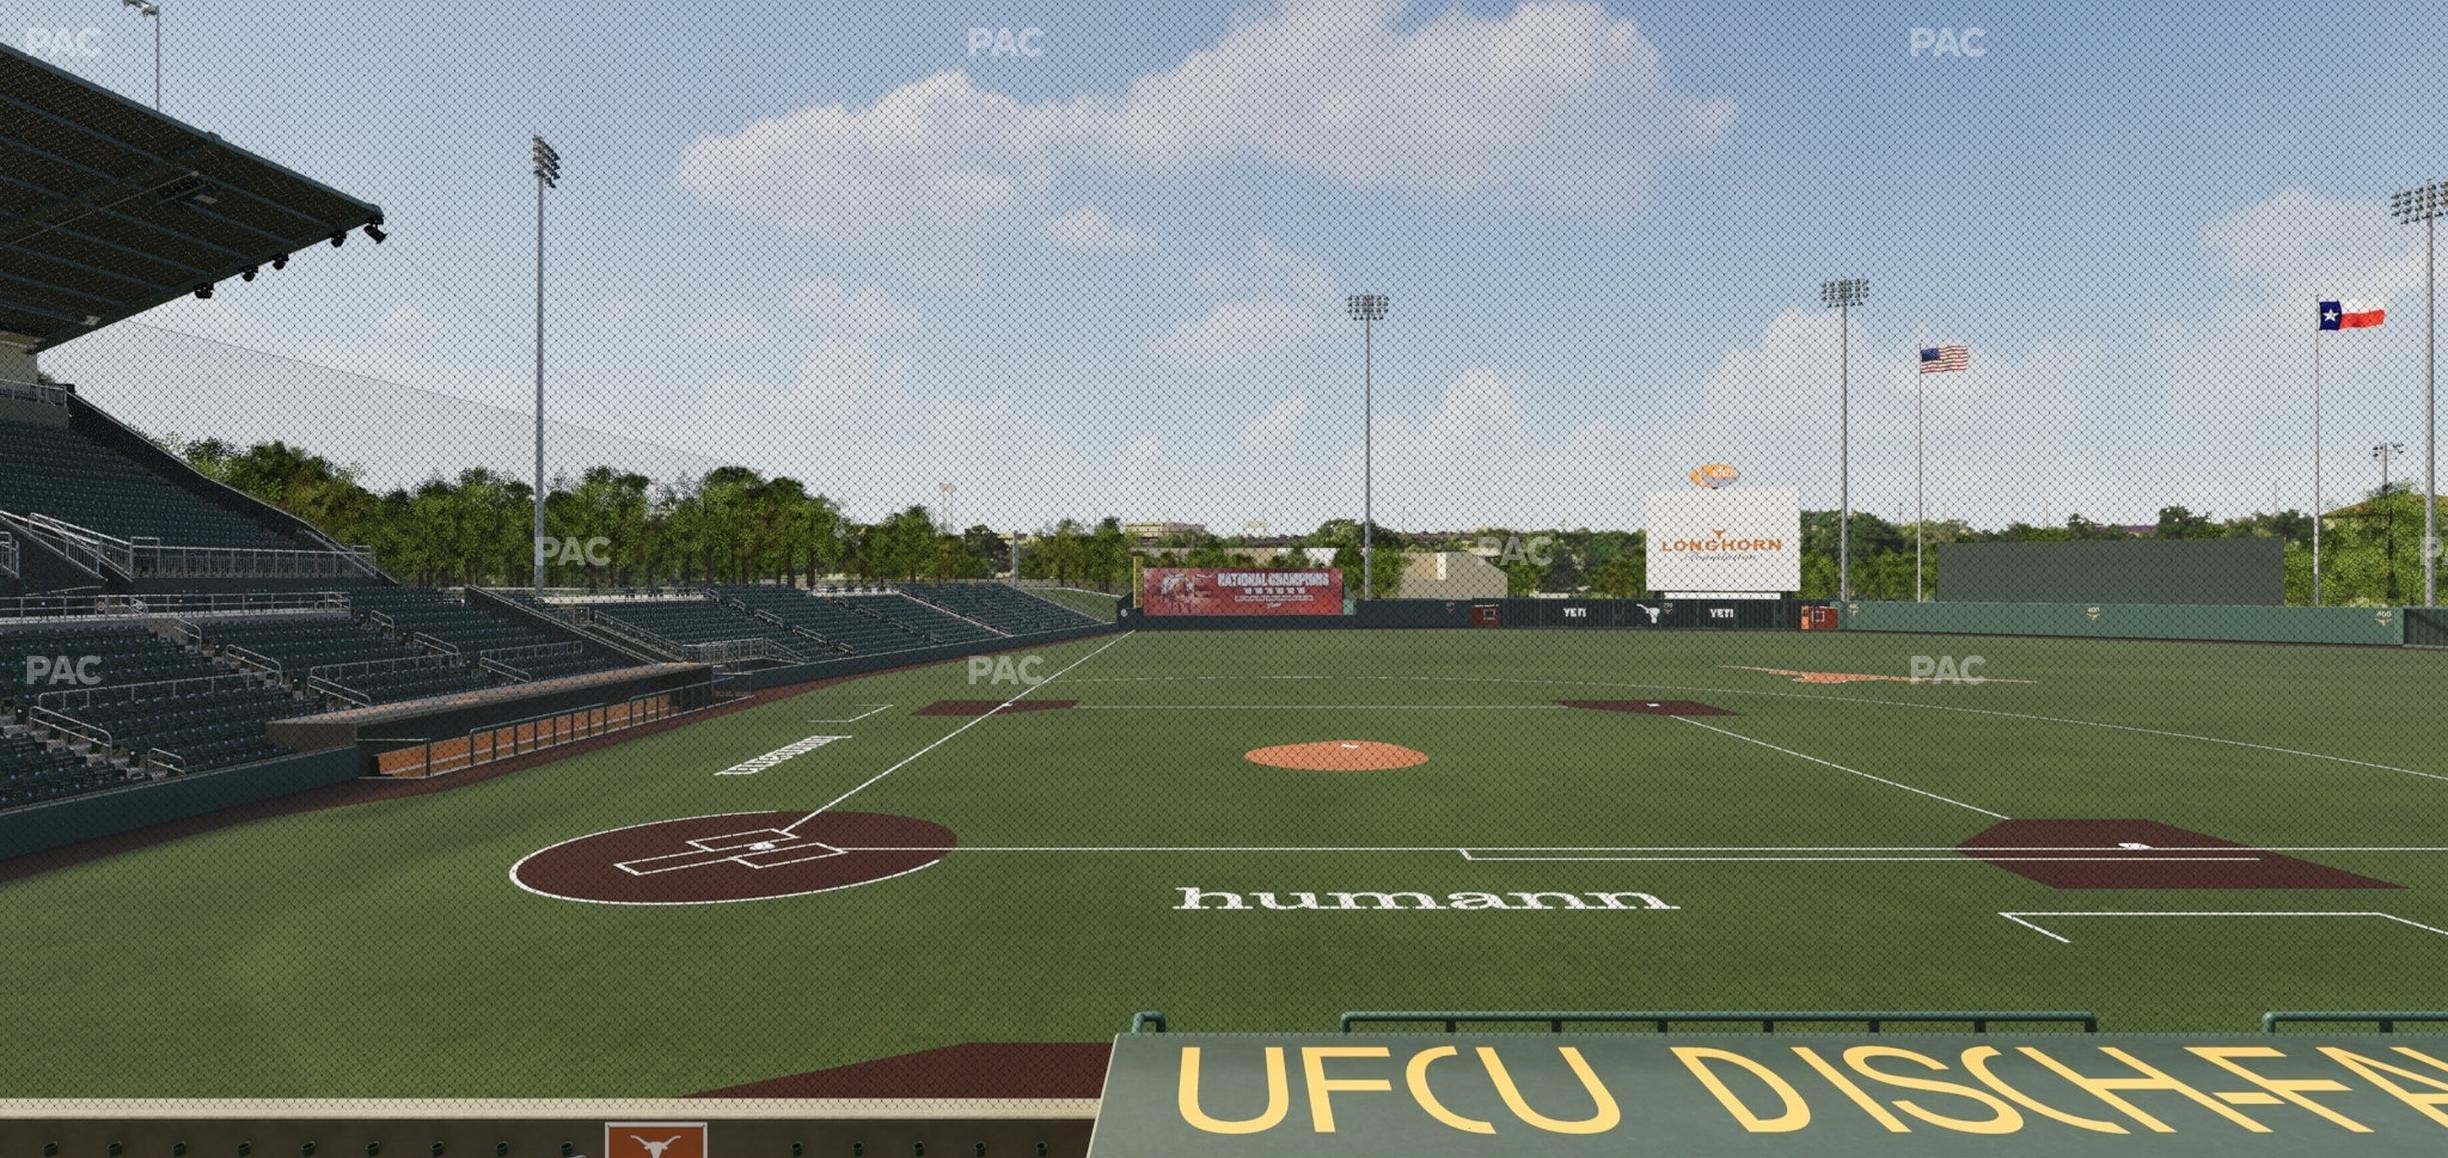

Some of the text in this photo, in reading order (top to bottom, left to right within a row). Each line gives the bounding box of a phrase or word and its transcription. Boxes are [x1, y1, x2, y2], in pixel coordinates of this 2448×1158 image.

[1662, 537, 1783, 552] LONGHORN
[1217, 573, 1330, 587] NATIONAL CHAMPIONS
[1563, 607, 1587, 618] YETI
[1710, 608, 1734, 618] YETI
[1172, 886, 1682, 911] humann
[1178, 1045, 1621, 1135] UFCU
